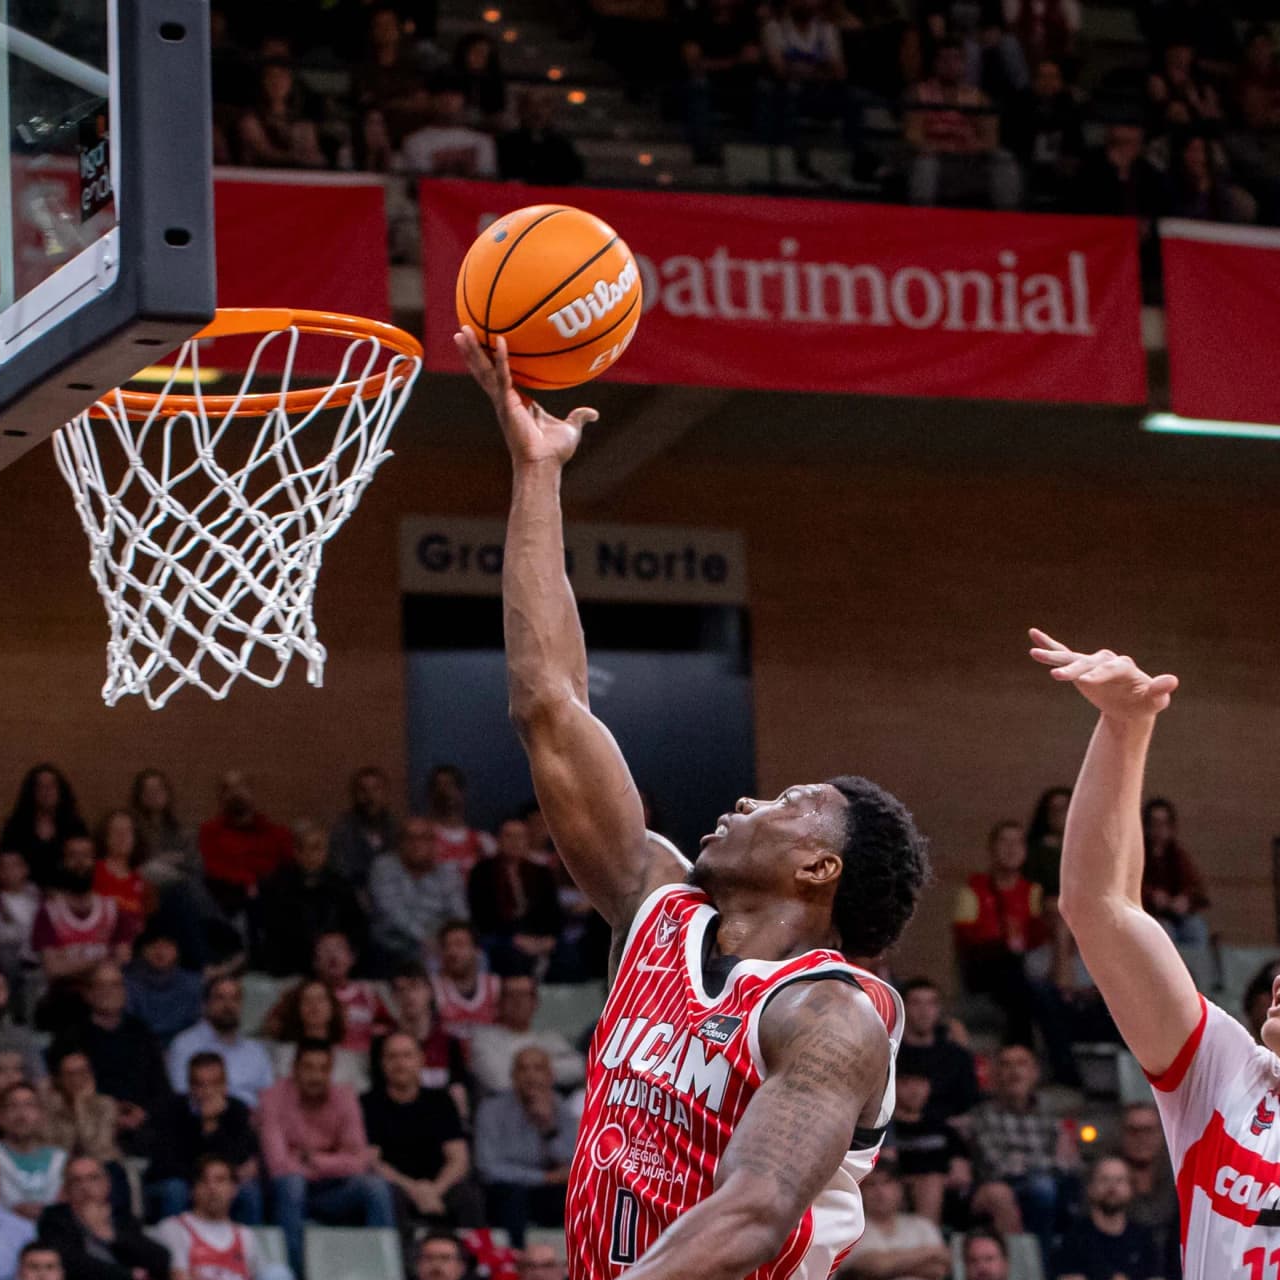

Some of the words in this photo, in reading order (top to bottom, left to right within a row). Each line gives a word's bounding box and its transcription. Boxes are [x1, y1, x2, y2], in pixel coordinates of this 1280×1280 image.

[547, 258, 640, 339] Wilson
[416, 533, 577, 576] Gra
[596, 542, 729, 583] Norte
[601, 1016, 732, 1113] UCAM
[607, 1078, 690, 1132] MURCIA
